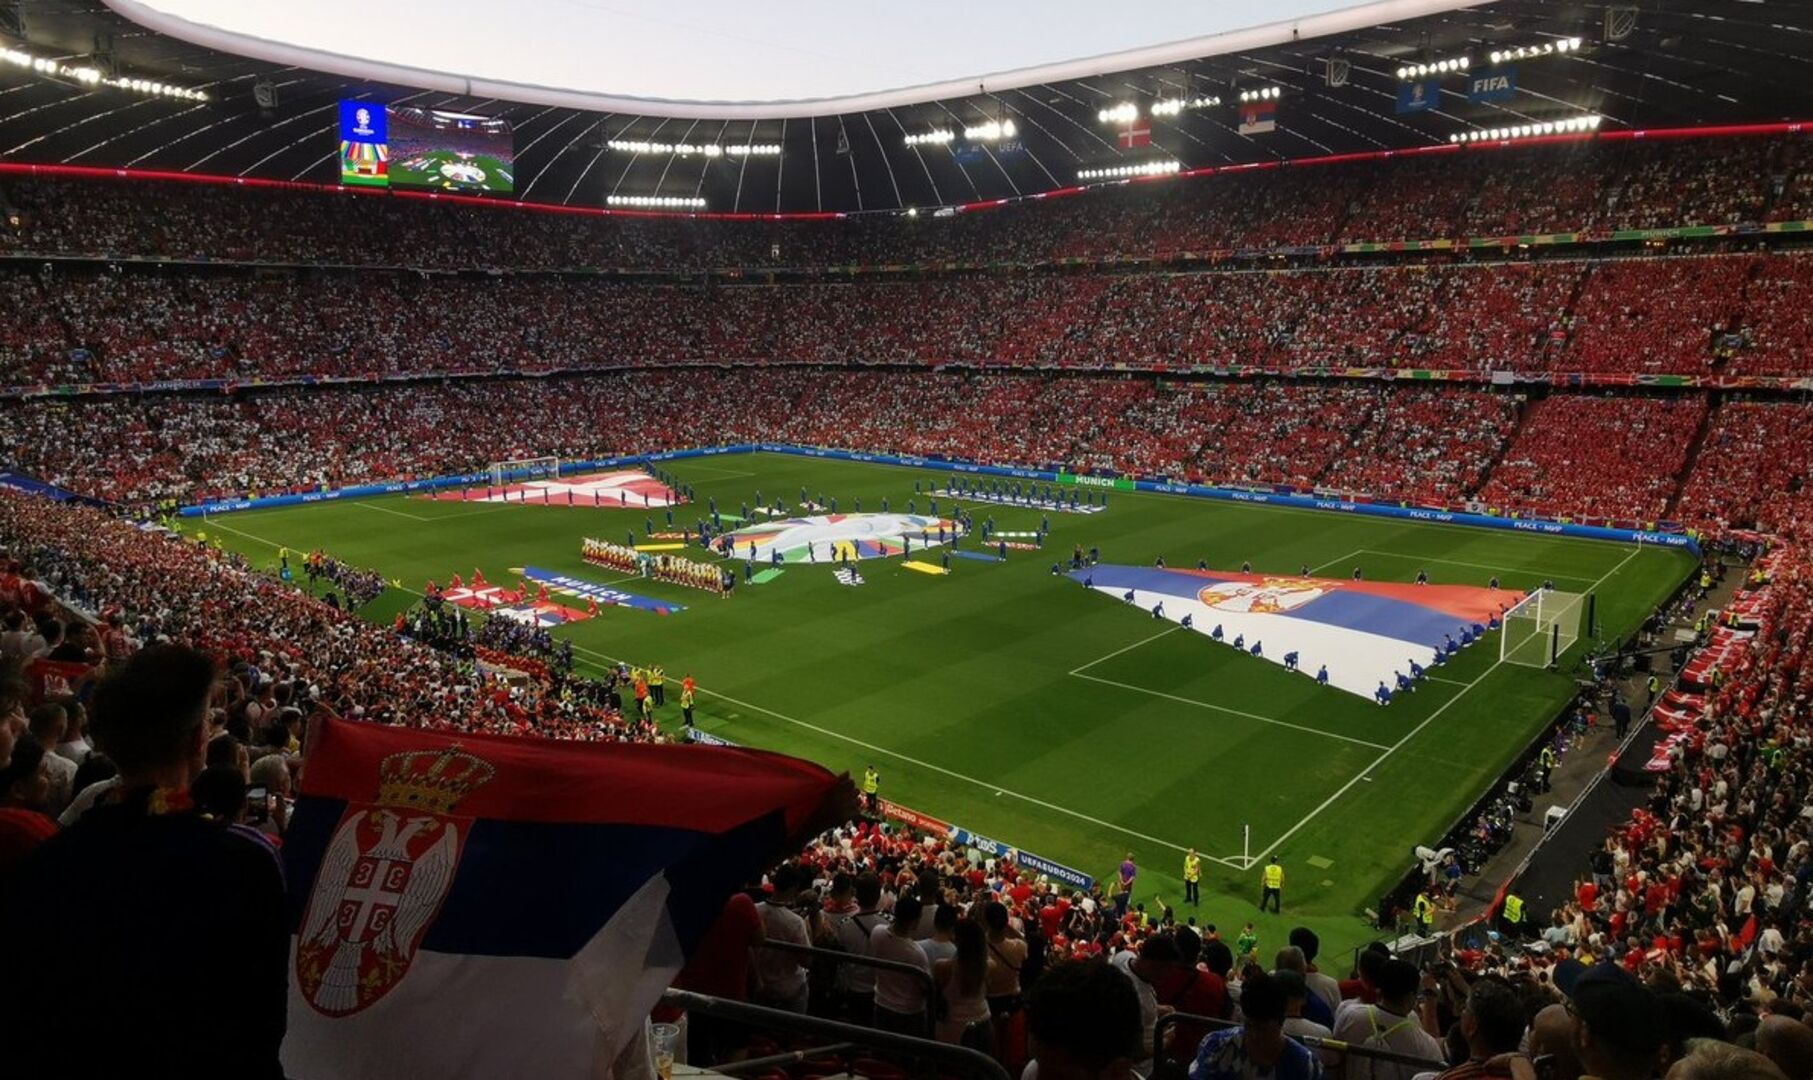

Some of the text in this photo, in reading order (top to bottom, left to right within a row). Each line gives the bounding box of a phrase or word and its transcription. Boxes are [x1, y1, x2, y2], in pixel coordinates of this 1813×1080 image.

[1473, 76, 1509, 93] FIFA
[999, 142, 1024, 152] UEFA
[1075, 476, 1115, 487] MUNICH
[1409, 511, 1430, 520] PEACE
[1513, 521, 1537, 531] PEACE
[1632, 532, 1659, 543] PEACE
[551, 576, 633, 601] MUNICH
